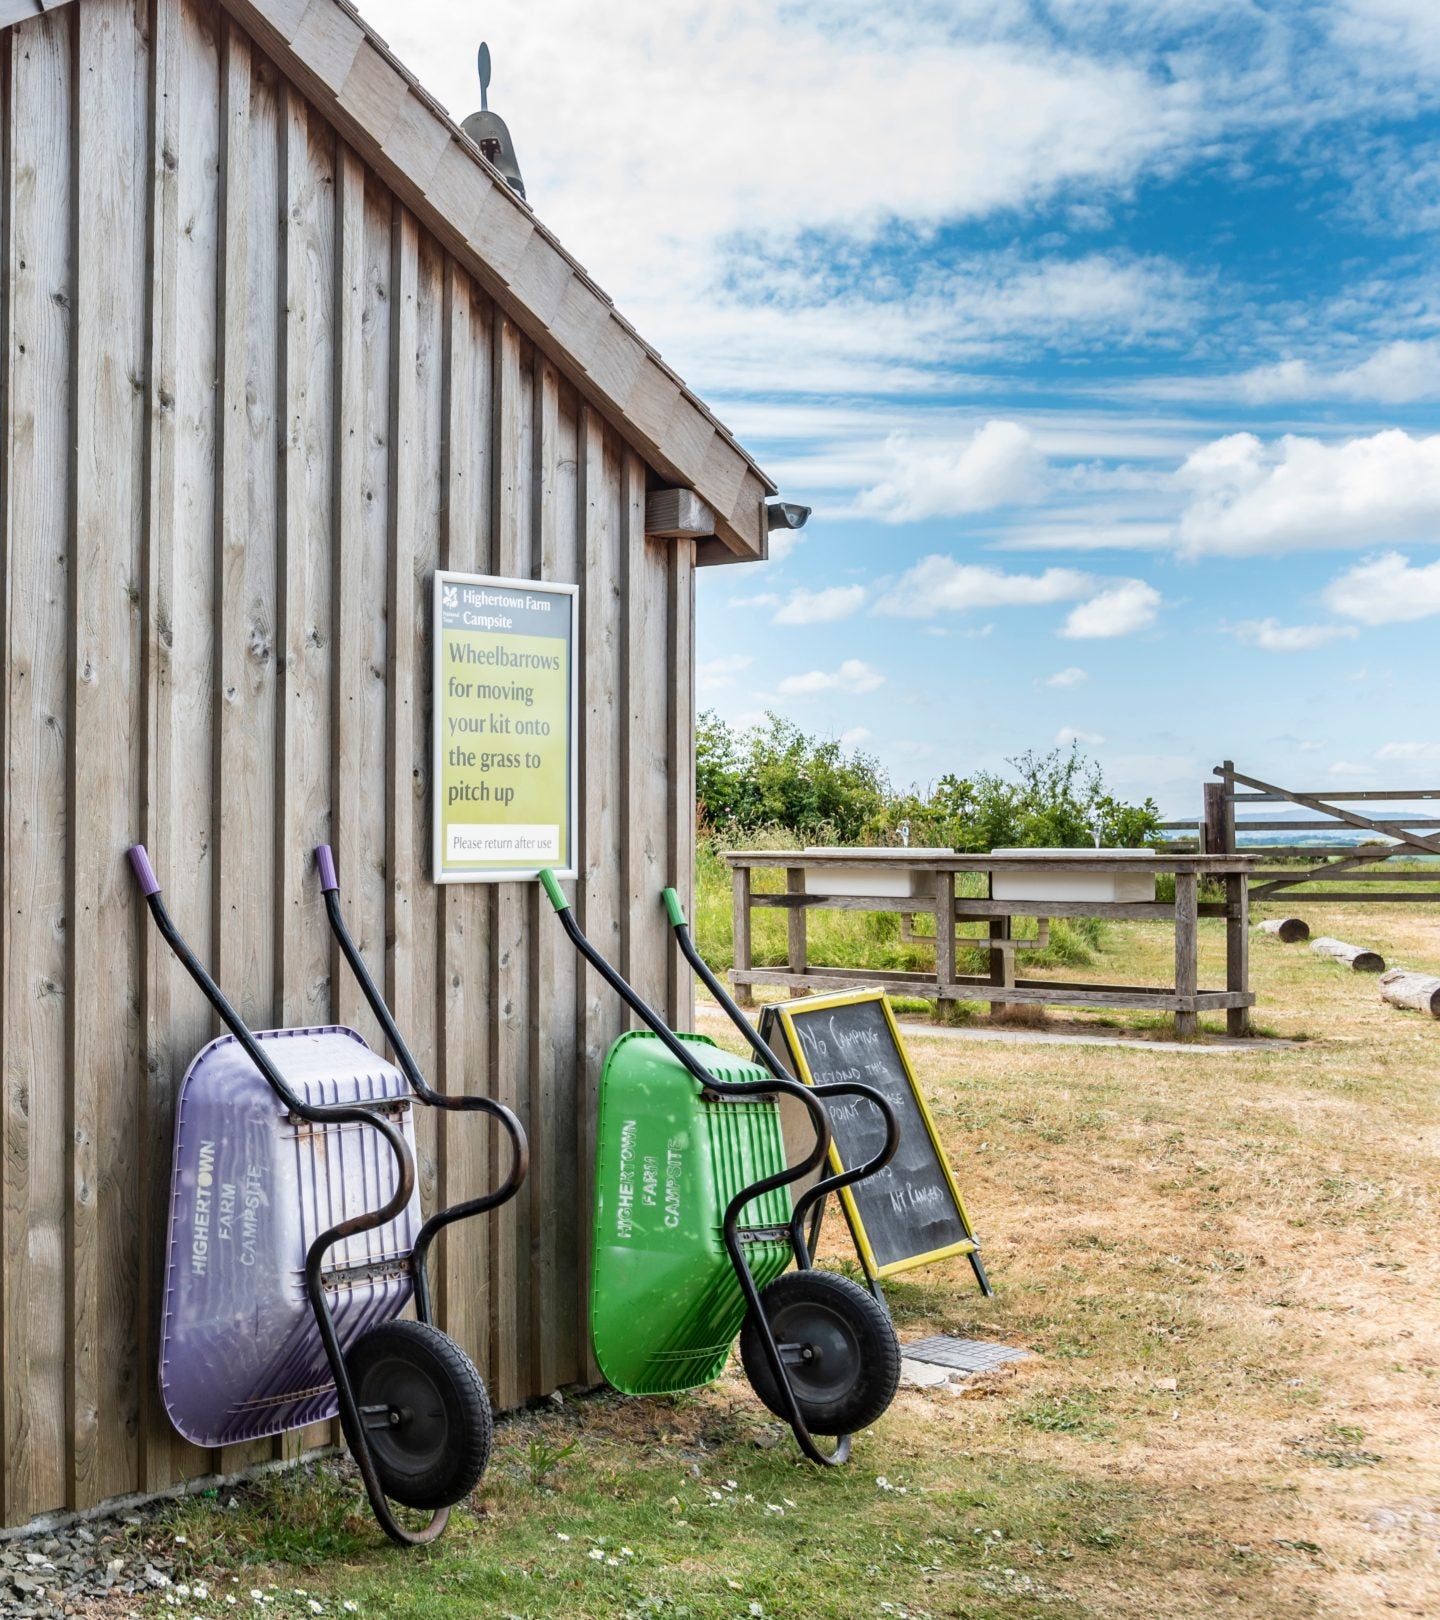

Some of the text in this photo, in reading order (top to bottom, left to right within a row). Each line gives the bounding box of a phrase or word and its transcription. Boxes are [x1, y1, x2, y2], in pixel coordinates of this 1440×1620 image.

[463, 589, 551, 612] Highertown Farm
[463, 611, 513, 629] Campsite
[449, 642, 560, 671] Wheelbarrows
[448, 676, 534, 707] for moving
[448, 713, 550, 736] your kit onto
[449, 746, 541, 772] the grass to
[448, 780, 515, 807] pitch up
[453, 836, 552, 849] Please return after use
[864, 1060, 889, 1076] THIS
[617, 1119, 637, 1238] HIGHERTOWN
[642, 1155, 658, 1206] FARM
[664, 1138, 682, 1229] CAMPSITE
[192, 1140, 215, 1276] HIGHERTOWN
[218, 1183, 237, 1240] FARM
[240, 1164, 262, 1266] CAMPSITE
